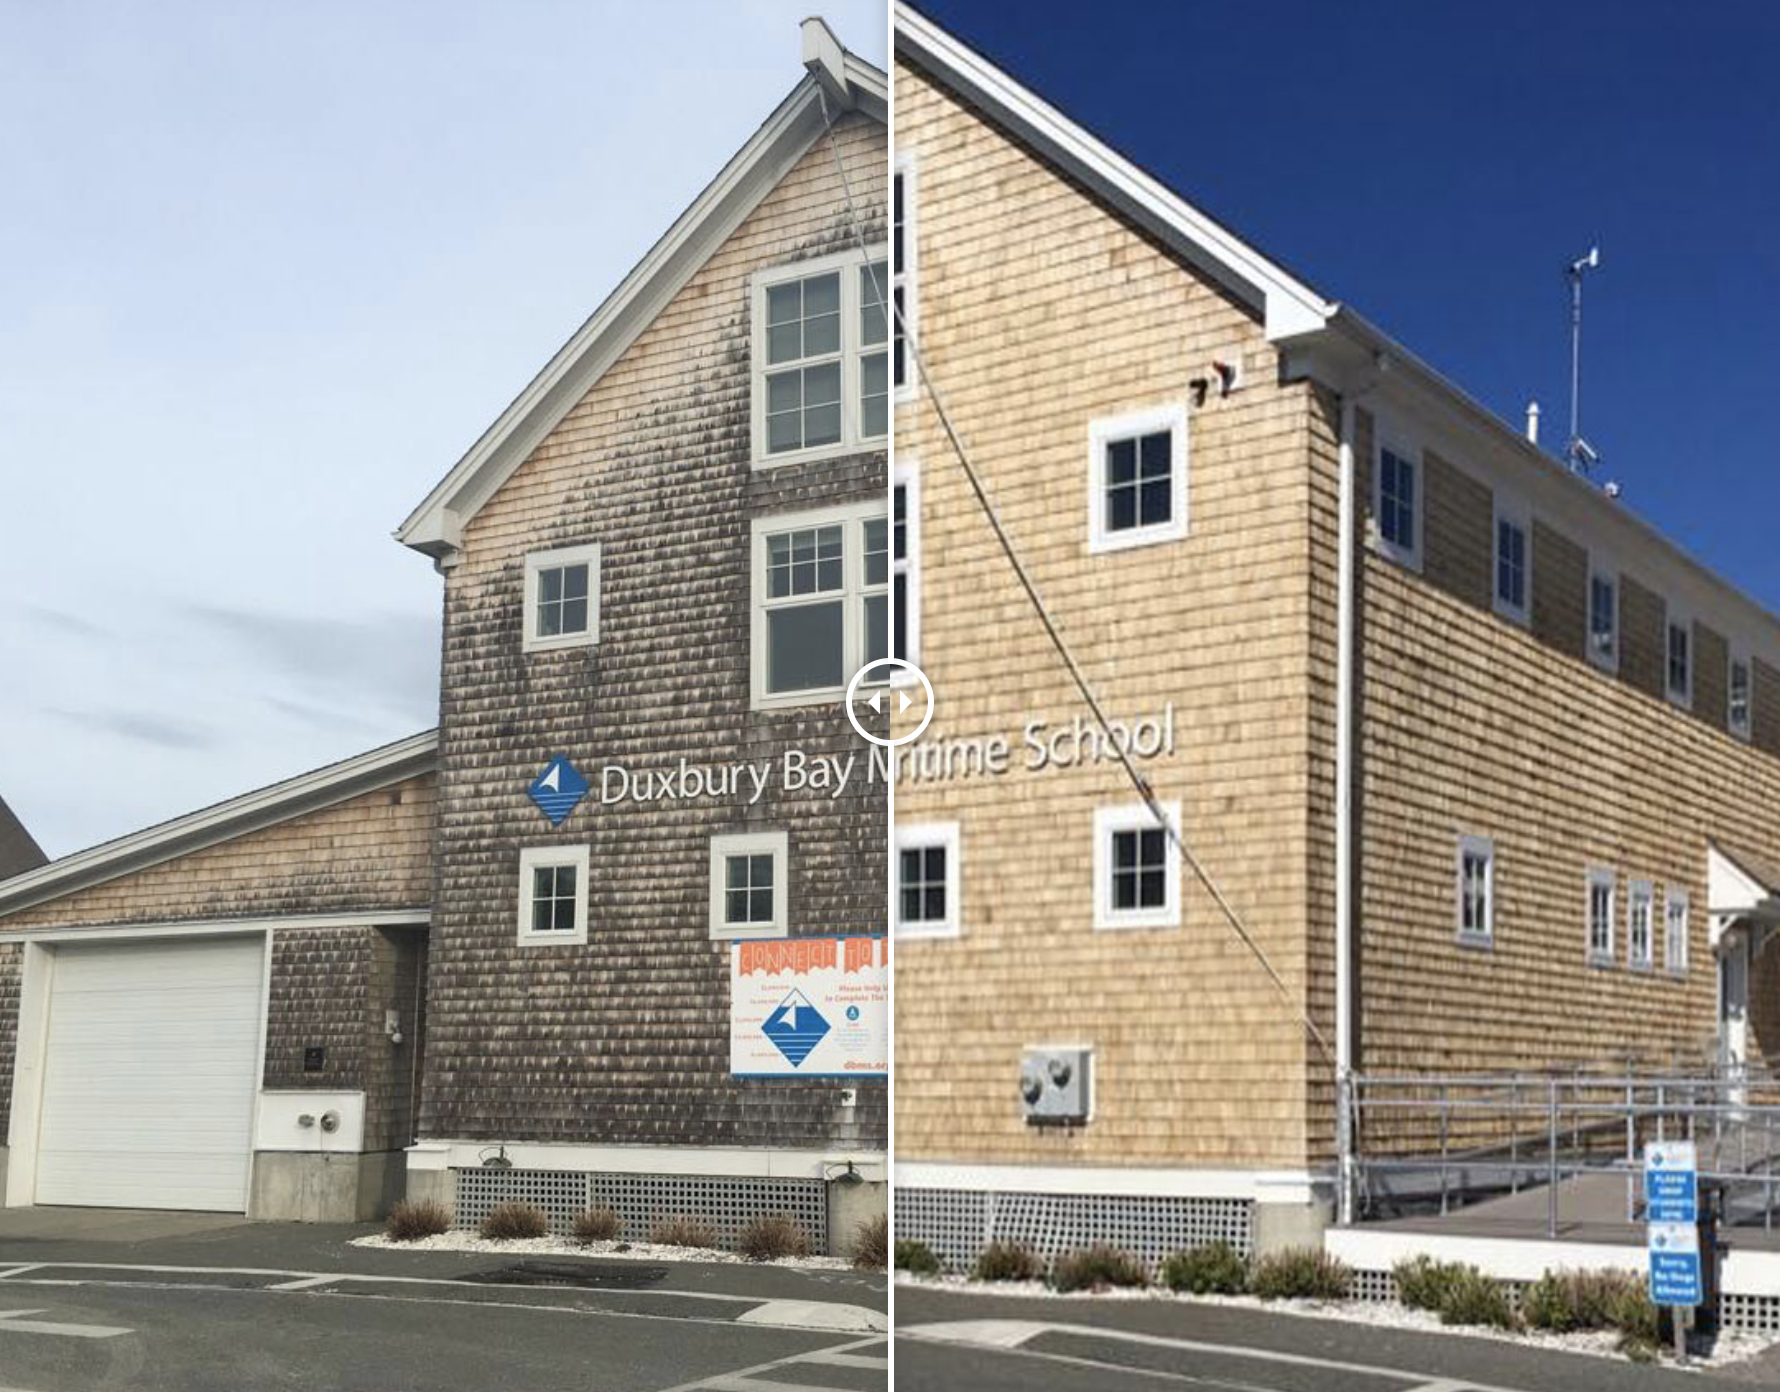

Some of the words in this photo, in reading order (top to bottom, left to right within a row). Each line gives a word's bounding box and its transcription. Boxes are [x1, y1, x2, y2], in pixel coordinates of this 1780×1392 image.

[1023, 701, 1175, 771] School
[600, 757, 772, 805] Duxbury
[783, 750, 855, 799] Bay
[740, 943, 835, 971] CONNECT
[846, 943, 872, 969] TO
